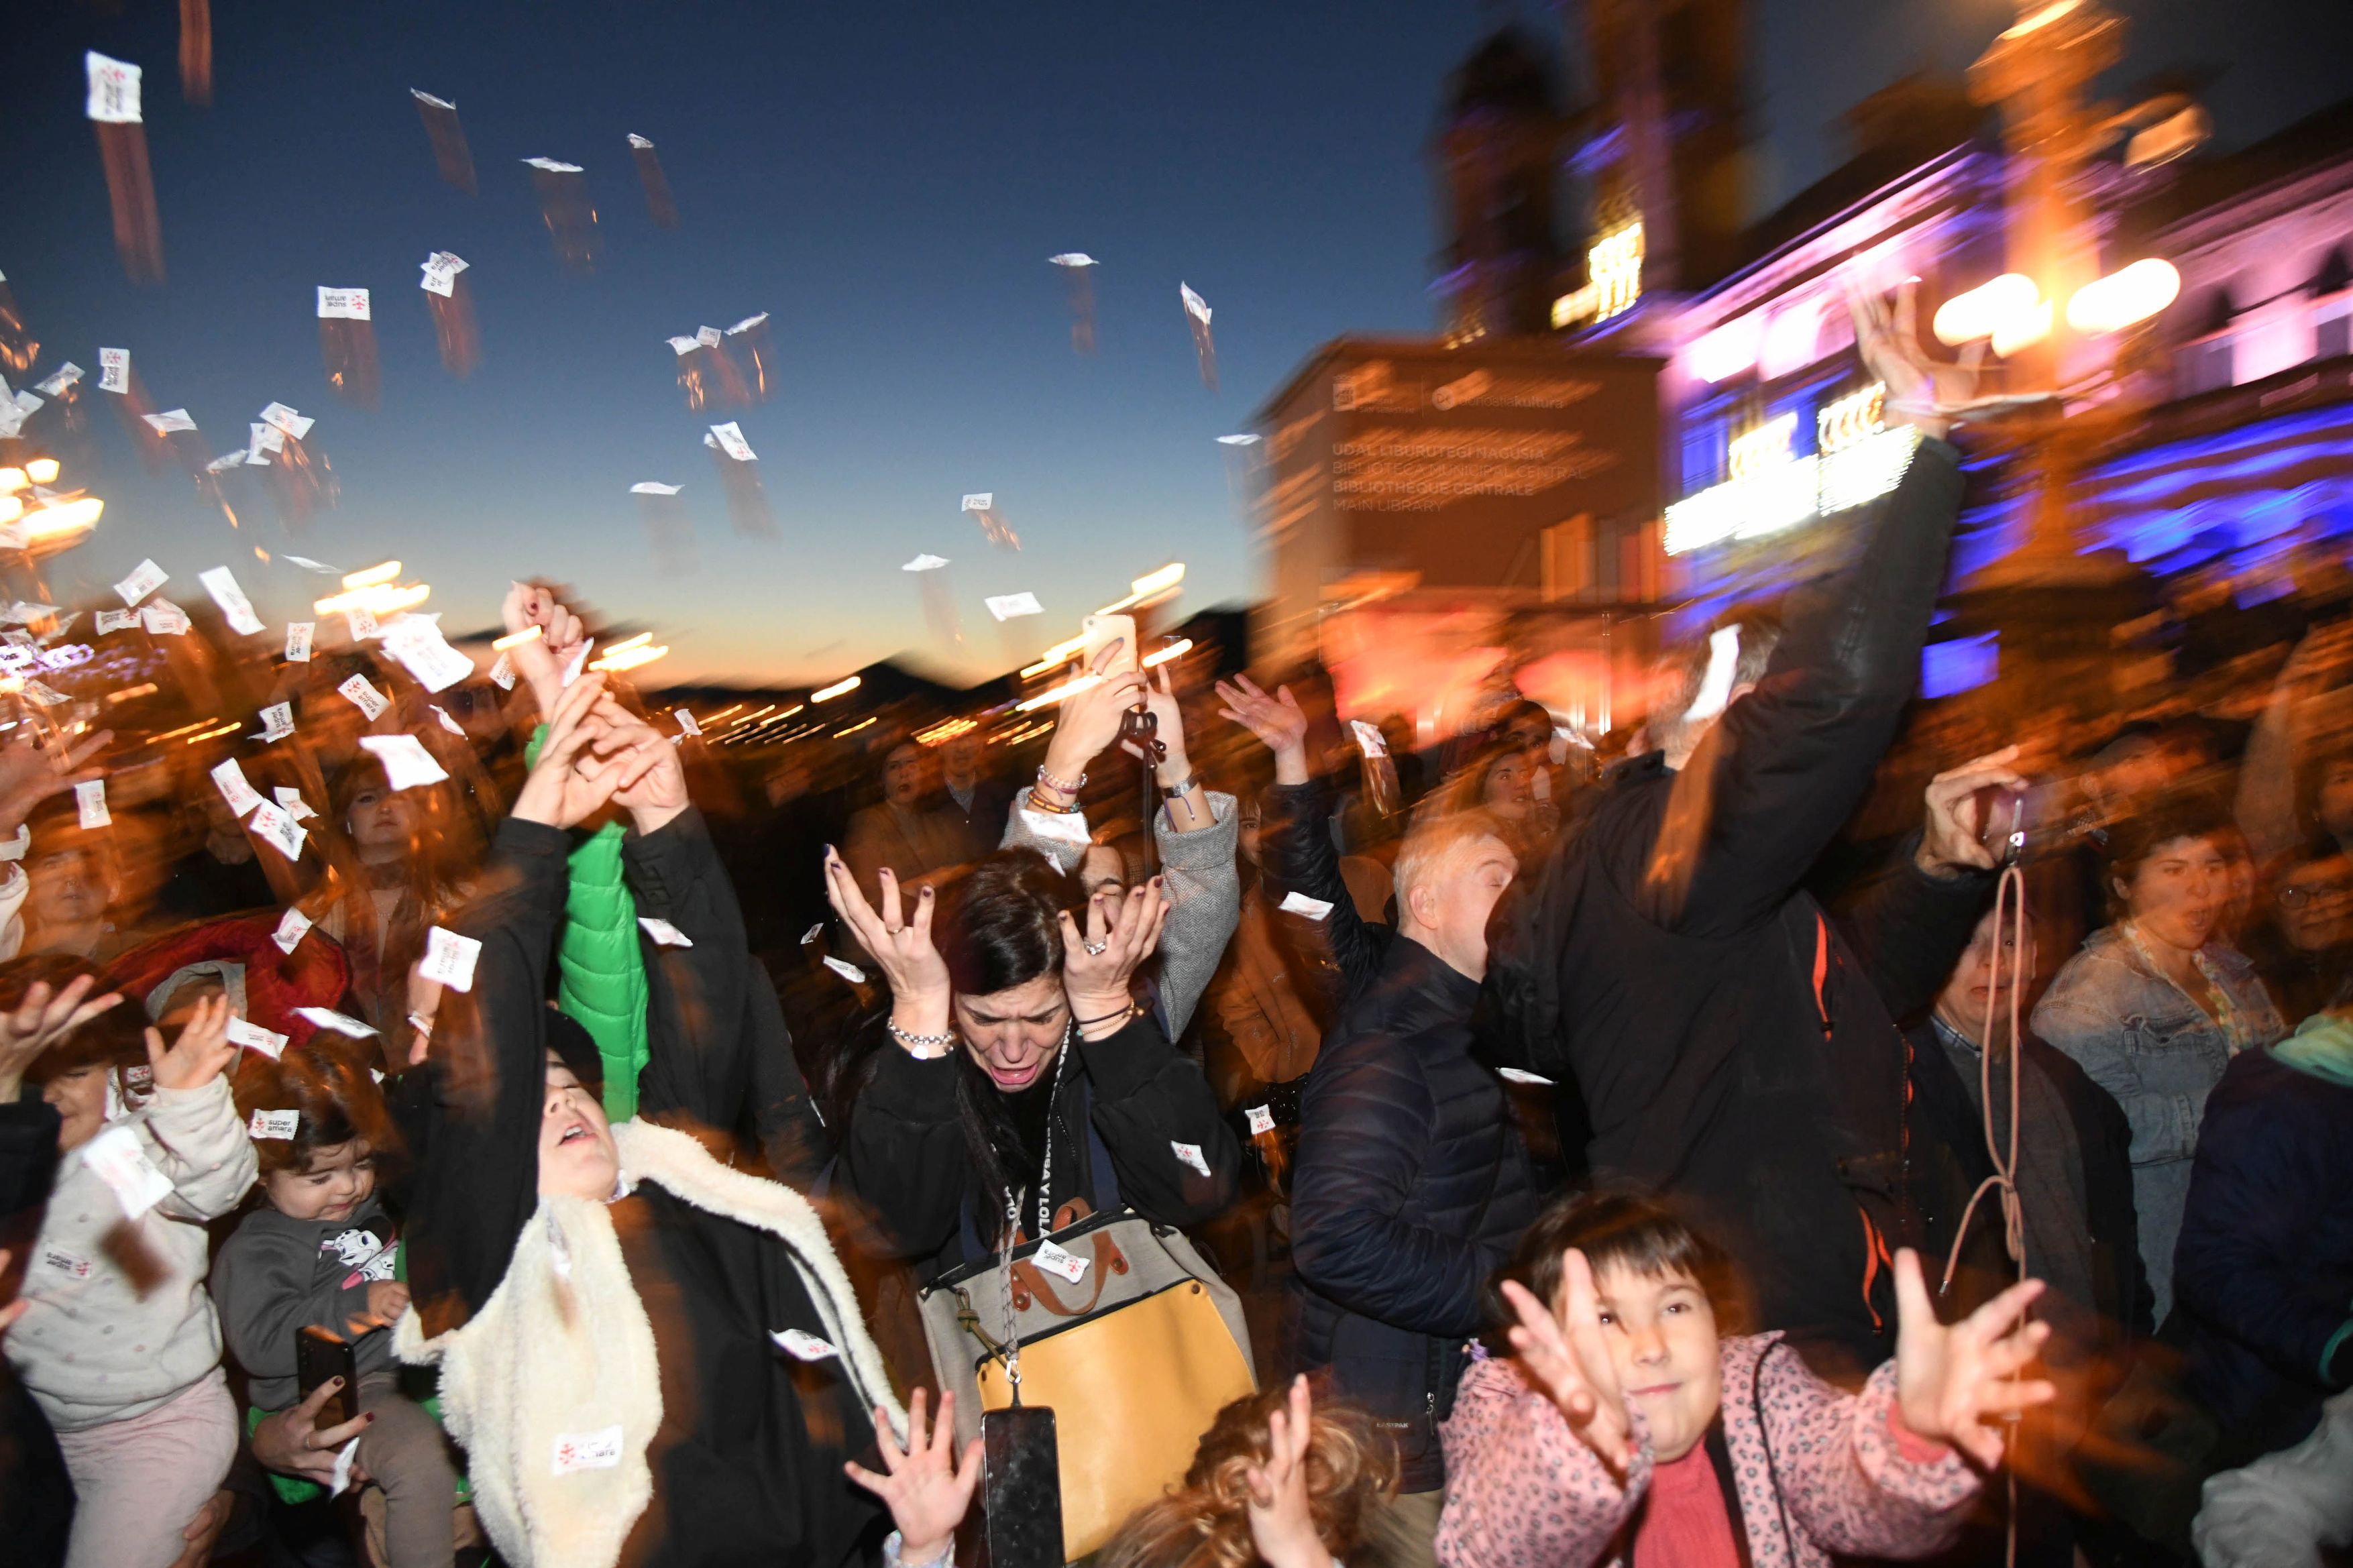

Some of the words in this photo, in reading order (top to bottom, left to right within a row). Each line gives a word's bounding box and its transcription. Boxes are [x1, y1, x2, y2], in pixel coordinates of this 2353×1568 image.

[1333, 443, 1377, 457] UDAL
[1380, 445, 1472, 459] LIBURUTEGI
[1476, 447, 1545, 461] NAGUSIA
[1333, 461, 1425, 476] BIBLIOTECA
[1429, 463, 1511, 479] MUNICIPAL
[1517, 465, 1587, 480] CENTRAL
[1454, 482, 1534, 497] CENTRALE
[1333, 498, 1373, 512] MAIN
[1378, 498, 1444, 512] LIBRARY
[358, 695, 376, 713] amara
[362, 691, 380, 708] super
[272, 712, 281, 728] super
[278, 708, 286, 726] amara
[1039, 1198, 1051, 1239] LOLA
